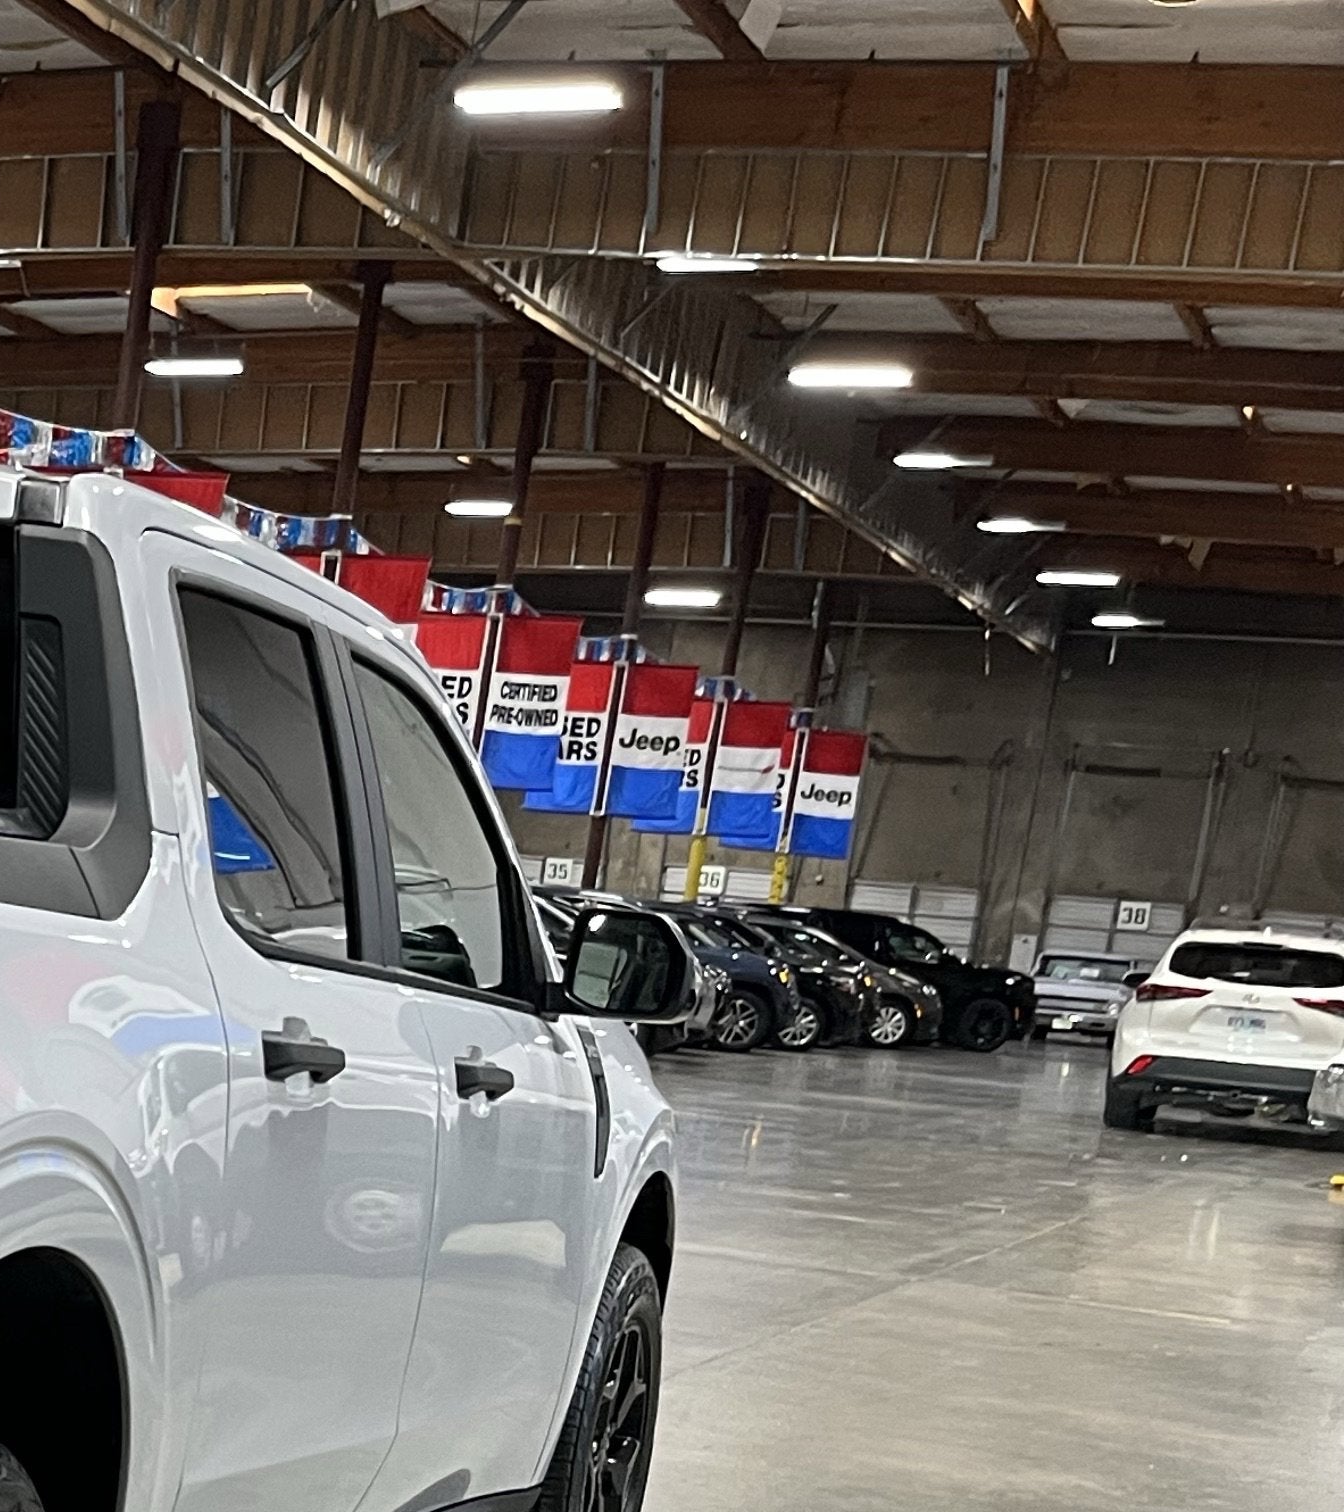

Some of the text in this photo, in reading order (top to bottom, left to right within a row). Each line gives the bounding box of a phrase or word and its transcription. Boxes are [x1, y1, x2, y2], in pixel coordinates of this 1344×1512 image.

[441, 675, 472, 699] ED
[500, 681, 558, 702] CERTIFIED
[490, 704, 559, 726] PRE-OWNED
[618, 728, 680, 756] Jeep
[800, 783, 852, 807] Jeep
[546, 863, 569, 881] 35
[699, 872, 720, 889] 36
[1121, 907, 1147, 925] 38
